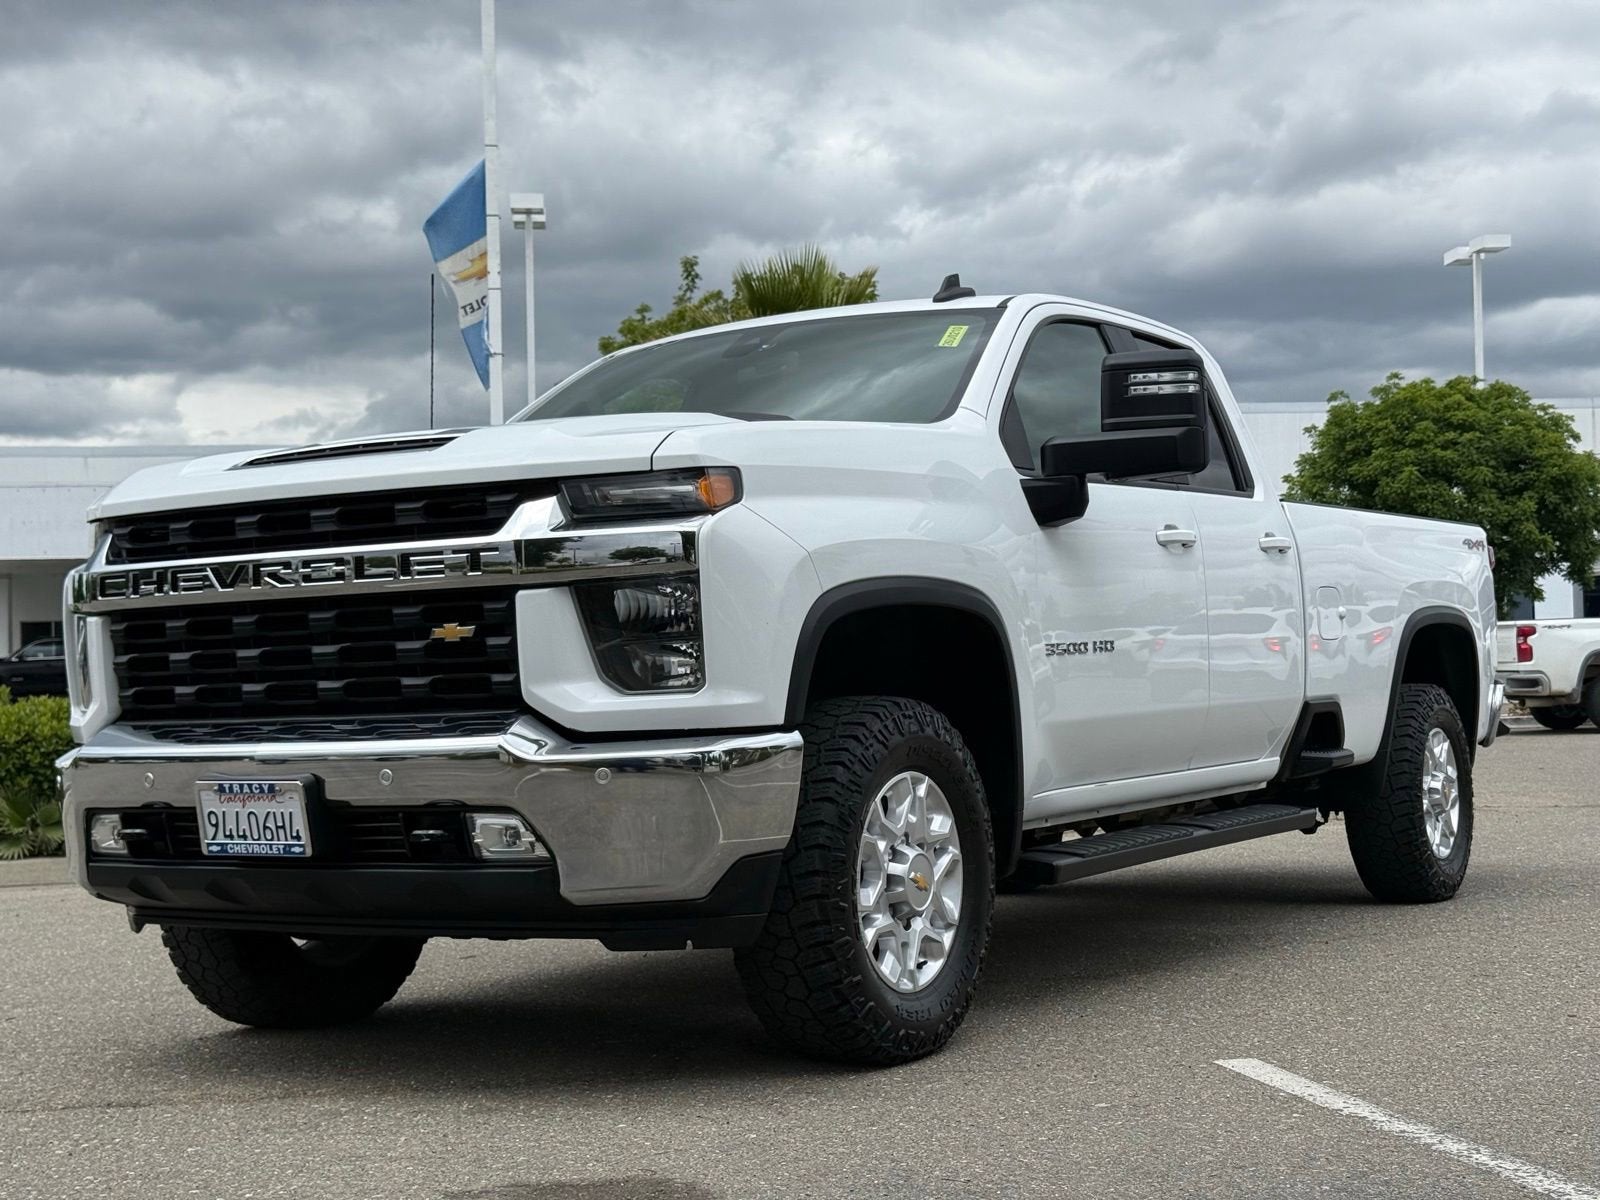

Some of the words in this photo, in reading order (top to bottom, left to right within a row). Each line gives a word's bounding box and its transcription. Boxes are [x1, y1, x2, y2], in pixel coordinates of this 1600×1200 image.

[98, 546, 500, 601] CHEVROLET
[1044, 642, 1089, 657] 3500
[1092, 640, 1115, 654] HD
[222, 783, 271, 794] TRACY
[219, 794, 285, 808] California
[207, 810, 302, 842] 94406H4
[227, 843, 285, 855] CHEVROLET
